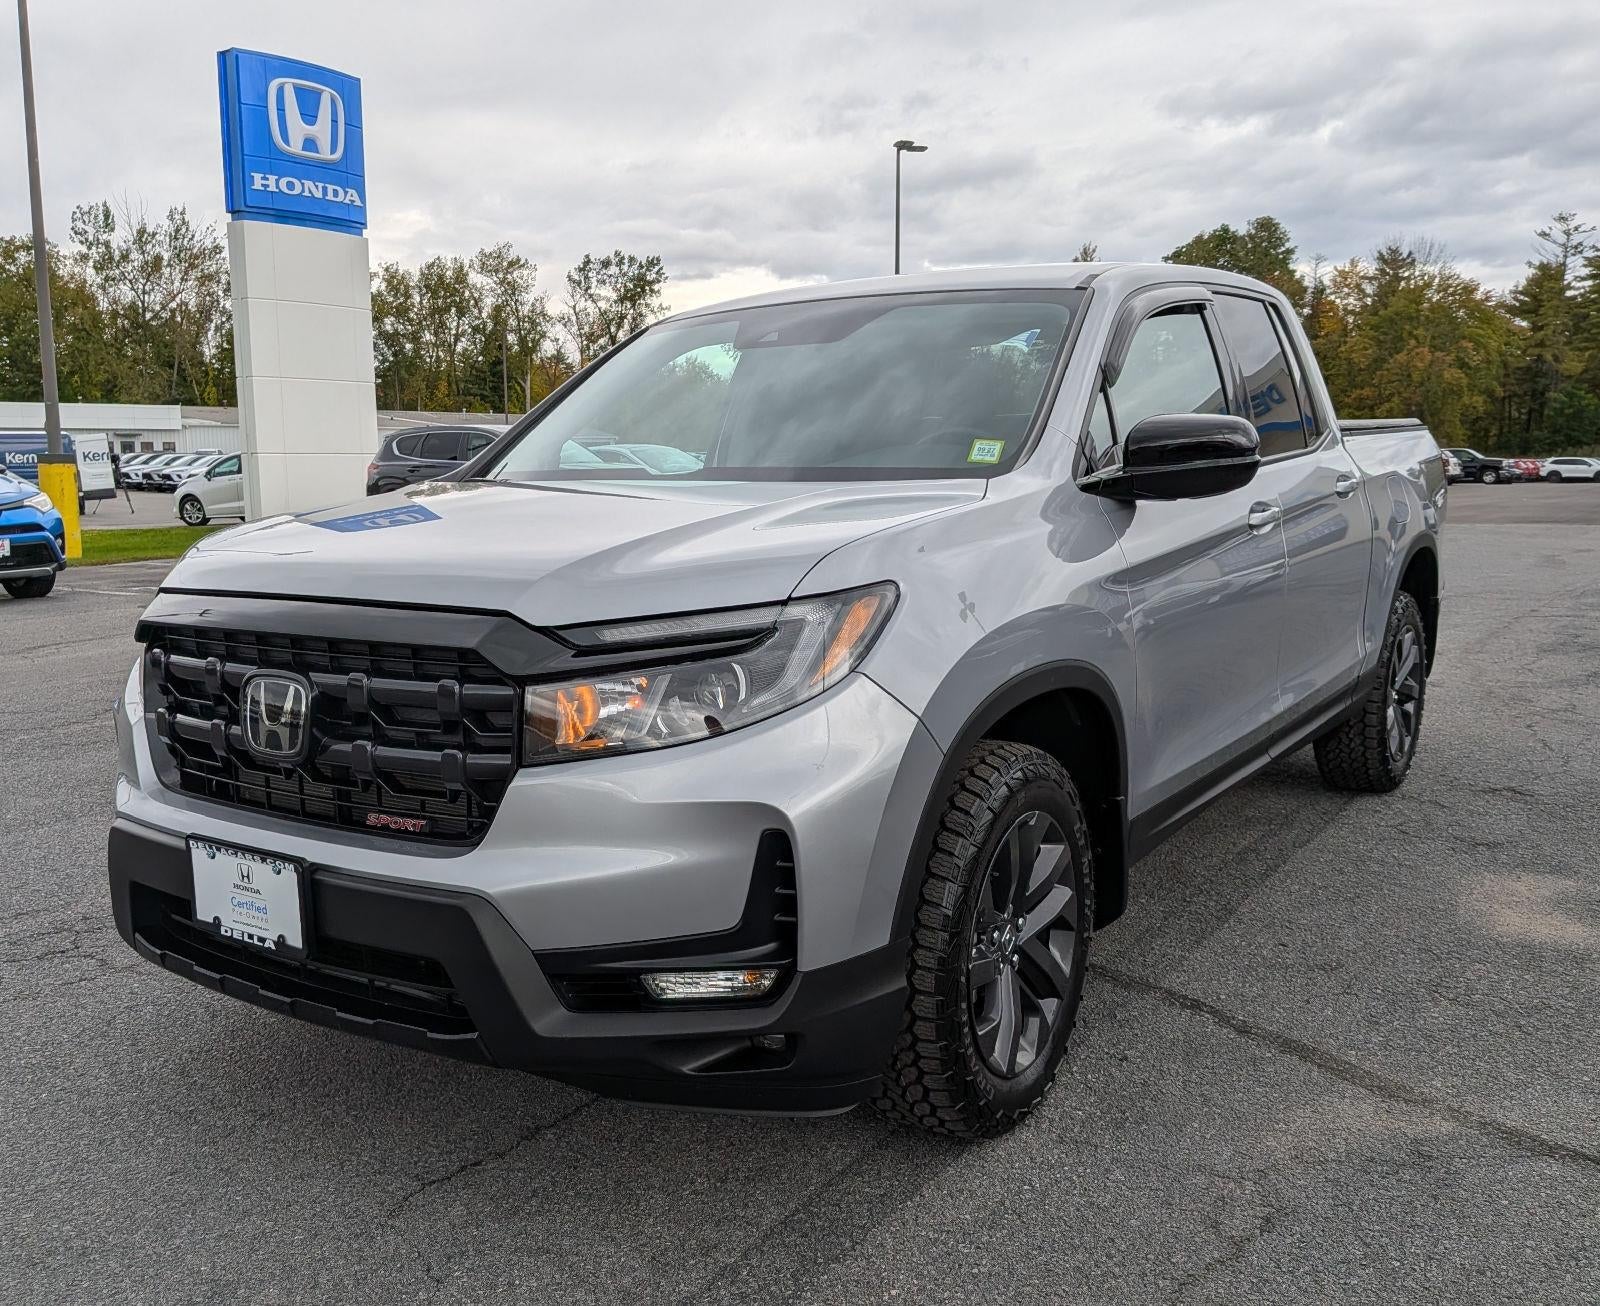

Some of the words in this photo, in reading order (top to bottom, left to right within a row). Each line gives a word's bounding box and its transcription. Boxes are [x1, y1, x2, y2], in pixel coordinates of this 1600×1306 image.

[250, 172, 364, 207] HONDA
[5, 452, 38, 464] Kern
[366, 813, 426, 832] SPORT
[189, 840, 295, 873] DELLACARS.COM
[233, 883, 262, 896] HONDA
[231, 896, 268, 915] Certified
[220, 926, 277, 950] DELLA
